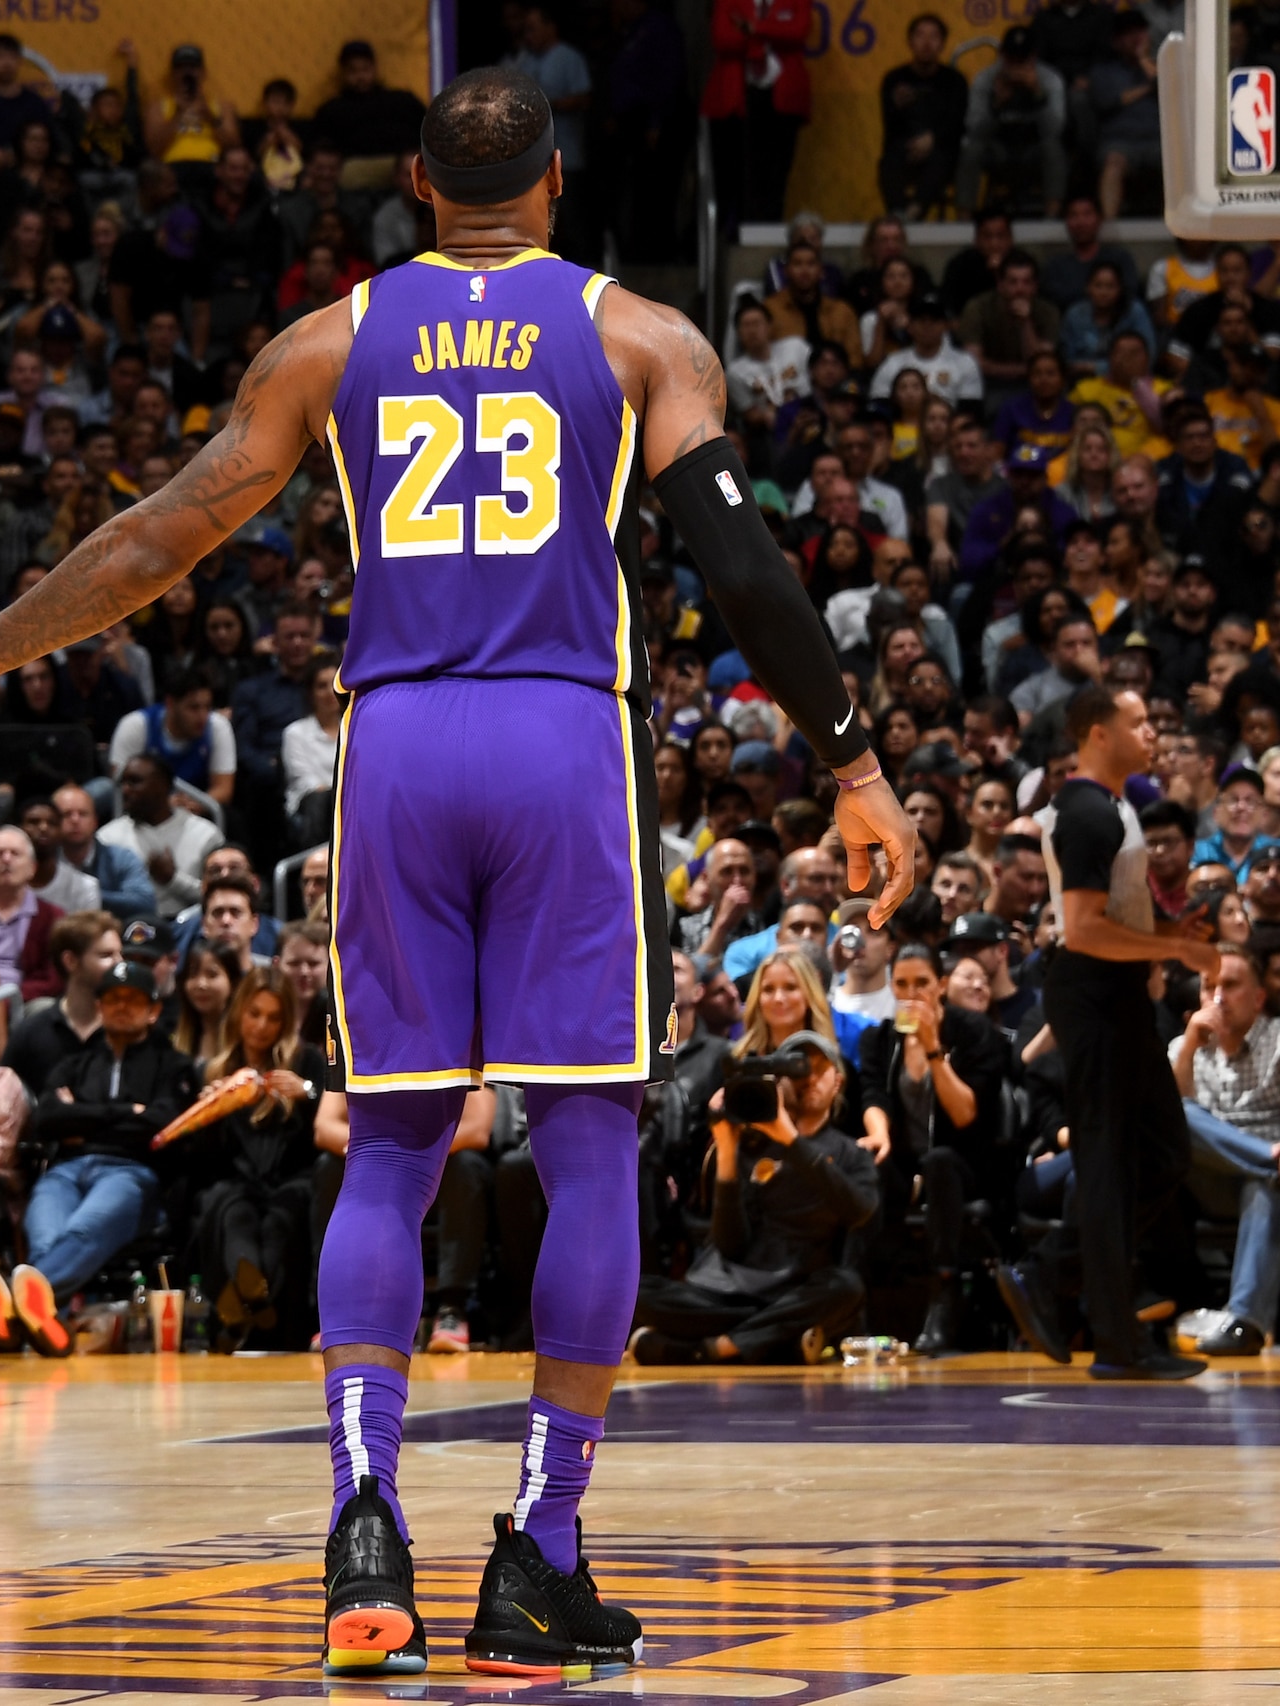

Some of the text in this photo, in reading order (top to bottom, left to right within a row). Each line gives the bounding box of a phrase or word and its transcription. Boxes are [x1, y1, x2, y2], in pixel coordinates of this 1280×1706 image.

[1234, 150, 1257, 168] NBA
[1219, 190, 1280, 206] SPALDIN
[412, 320, 540, 374] JAMES
[377, 391, 561, 558] 23
